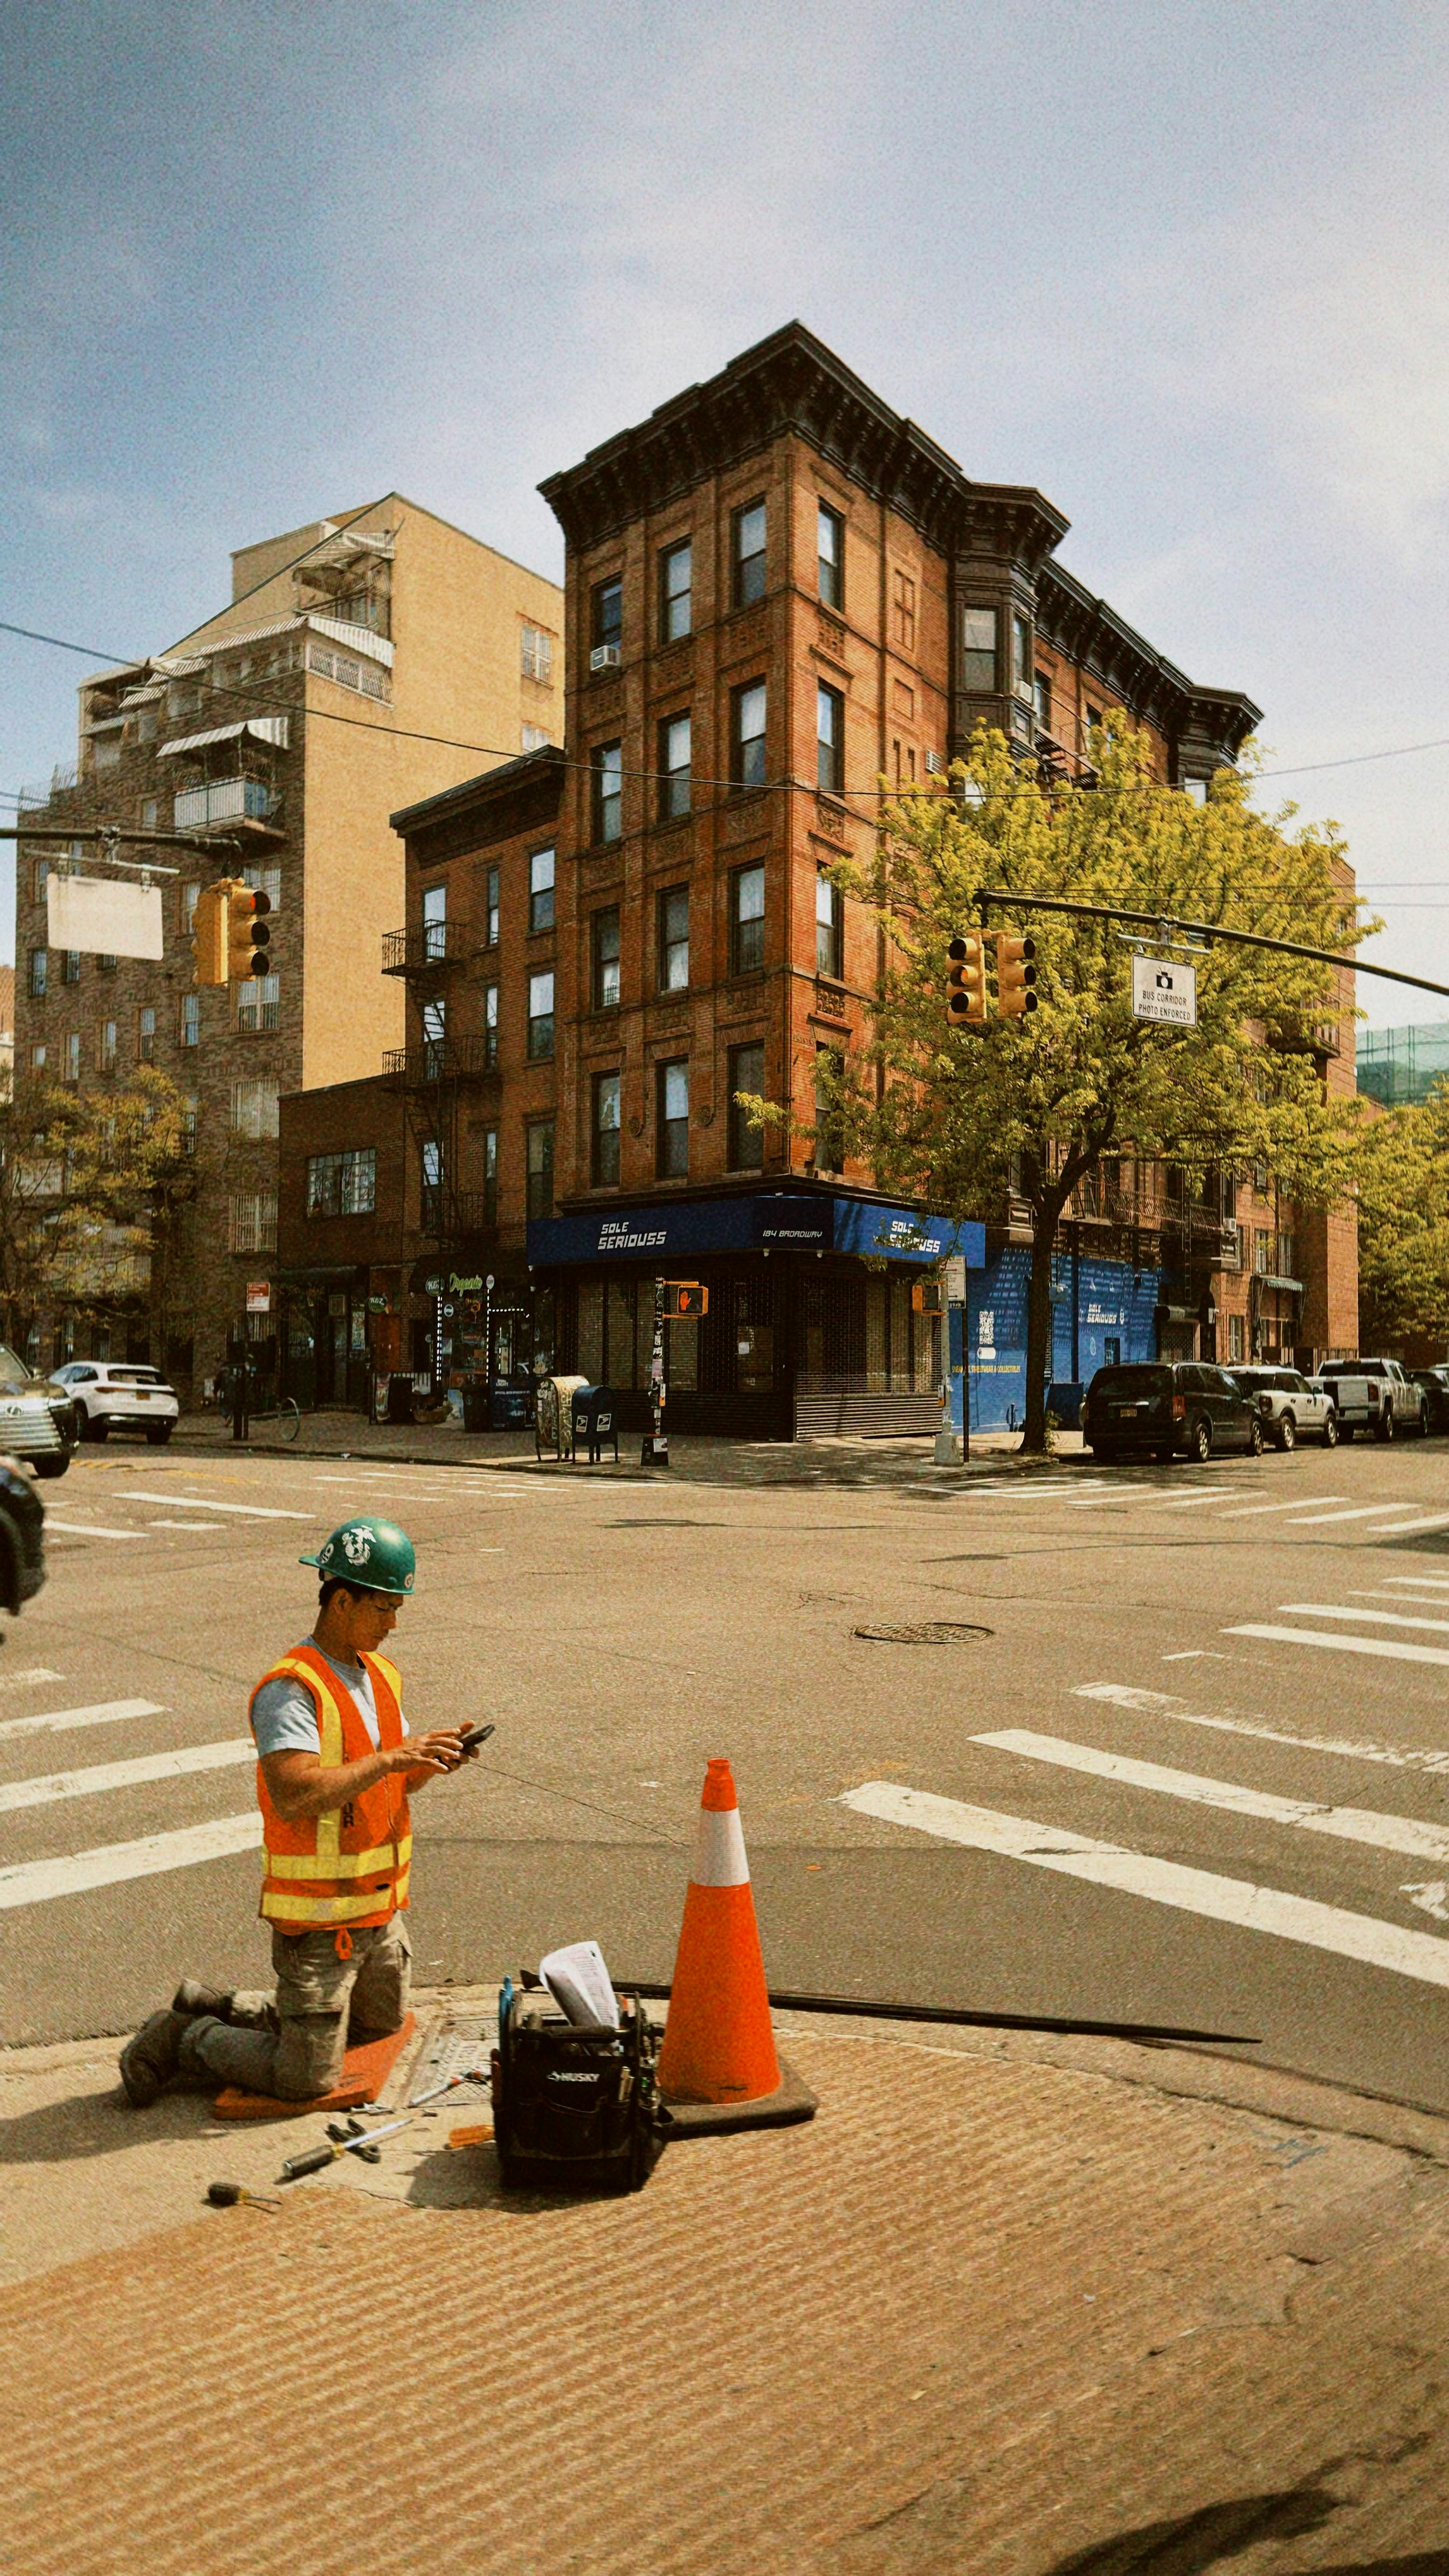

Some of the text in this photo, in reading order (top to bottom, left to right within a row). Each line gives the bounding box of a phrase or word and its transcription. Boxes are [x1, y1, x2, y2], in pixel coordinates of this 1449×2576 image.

[1142, 990, 1186, 1007] BUS CORRIDOR
[1138, 1003, 1191, 1021] PHOTO ENFORCED
[601, 1221, 629, 1235] SOLE
[597, 1231, 667, 1250] SERIOUSS
[1088, 1304, 1101, 1313] SOLE
[1087, 1313, 1117, 1324] SERIOUSS
[561, 2072, 601, 2082] HUSKY
